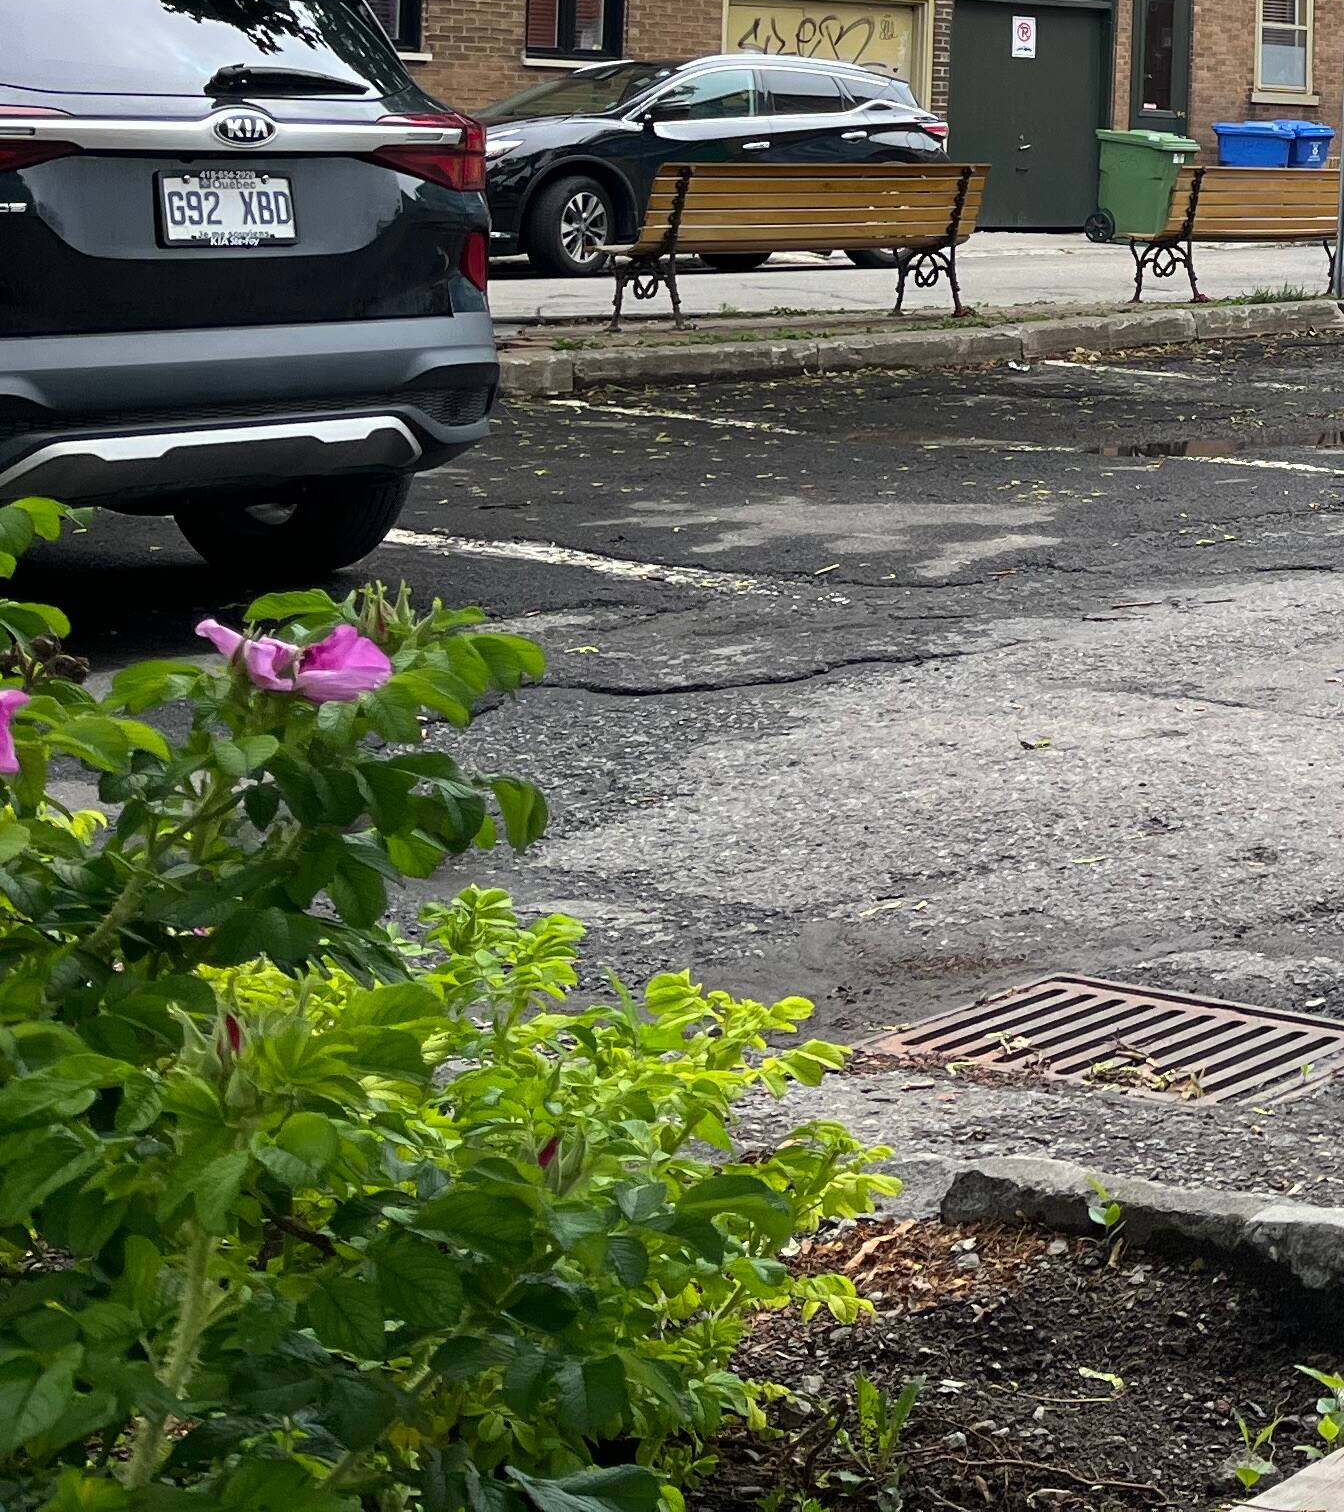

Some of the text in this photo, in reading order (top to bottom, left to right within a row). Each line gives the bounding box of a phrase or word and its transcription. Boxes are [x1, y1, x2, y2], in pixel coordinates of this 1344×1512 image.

[227, 118, 270, 138] KIA
[167, 190, 292, 225] G92 XBD
